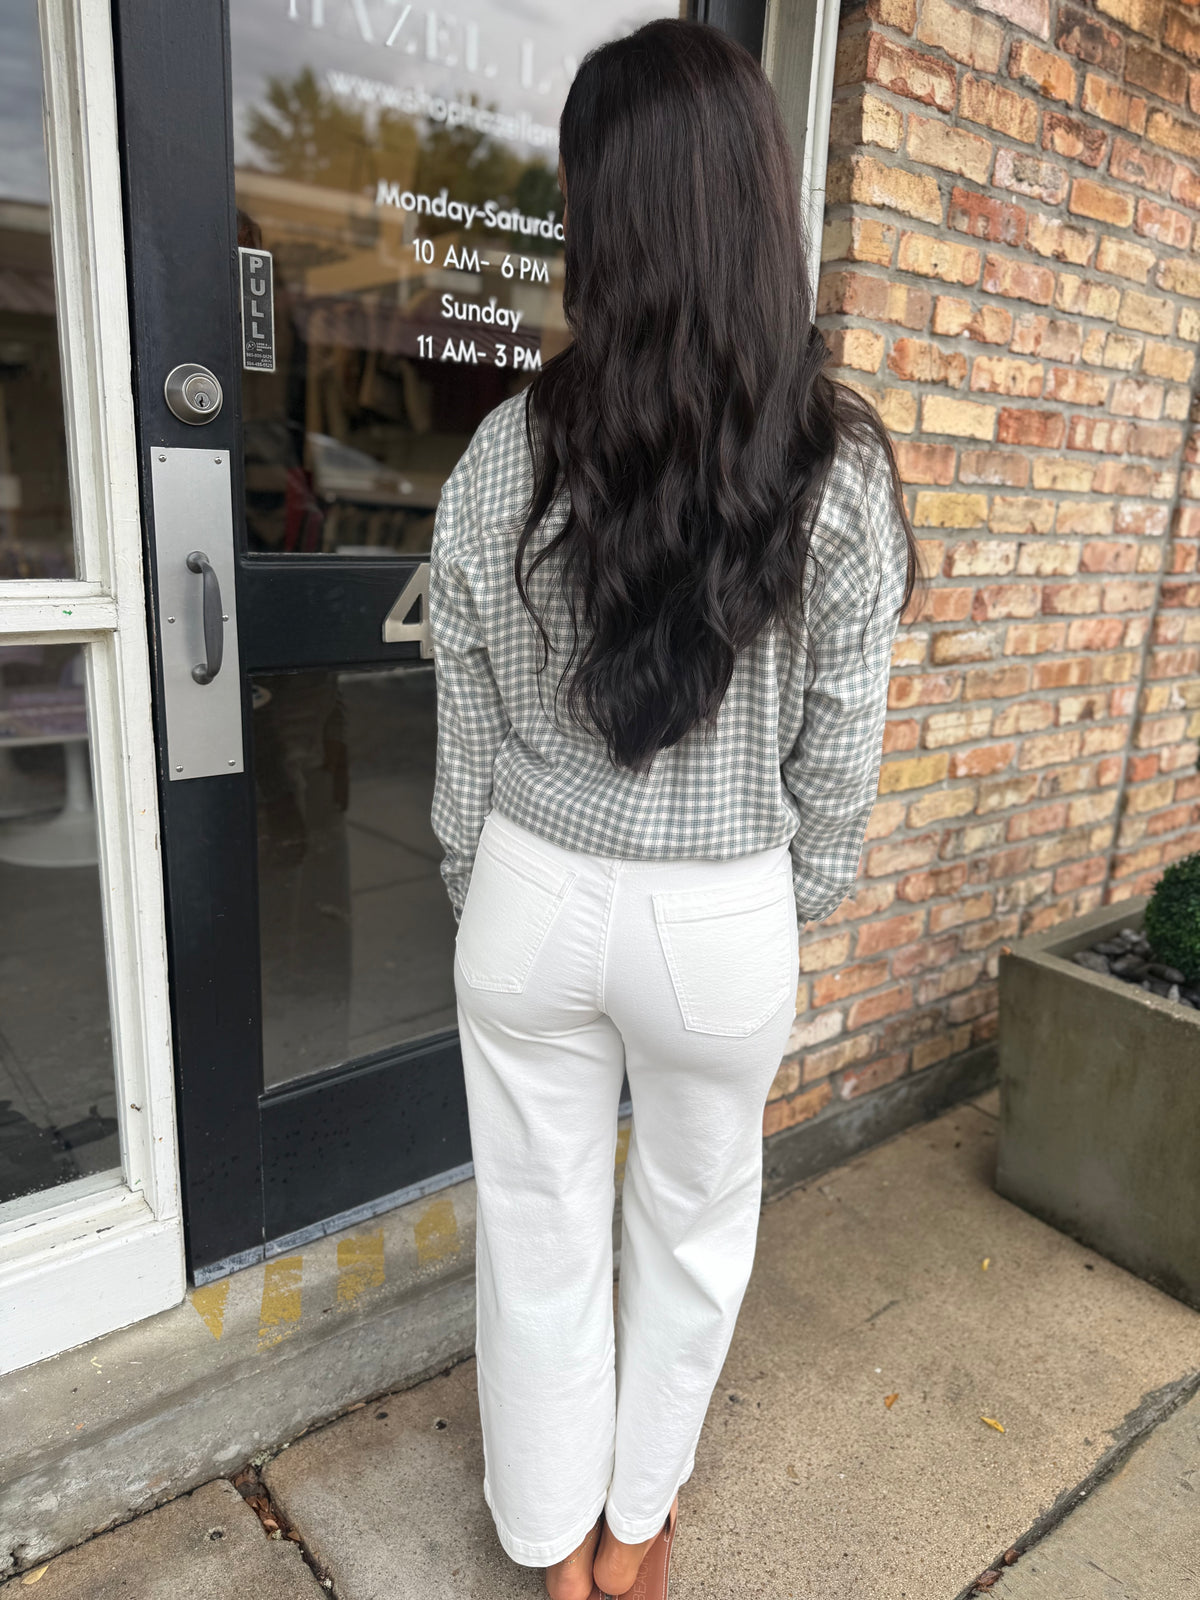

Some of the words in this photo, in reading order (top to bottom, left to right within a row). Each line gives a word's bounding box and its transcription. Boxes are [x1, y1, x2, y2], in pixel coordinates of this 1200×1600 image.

[413, 238, 434, 264] 10
[443, 244, 490, 273] AM-
[501, 254, 514, 279] 6
[520, 256, 549, 284] PM
[249, 256, 266, 339] PULL
[441, 294, 522, 333] Sunday
[417, 335, 433, 359] 11
[440, 338, 487, 365] AM-
[494, 344, 507, 367] 3
[513, 346, 542, 371] PM
[382, 562, 434, 659] 4
